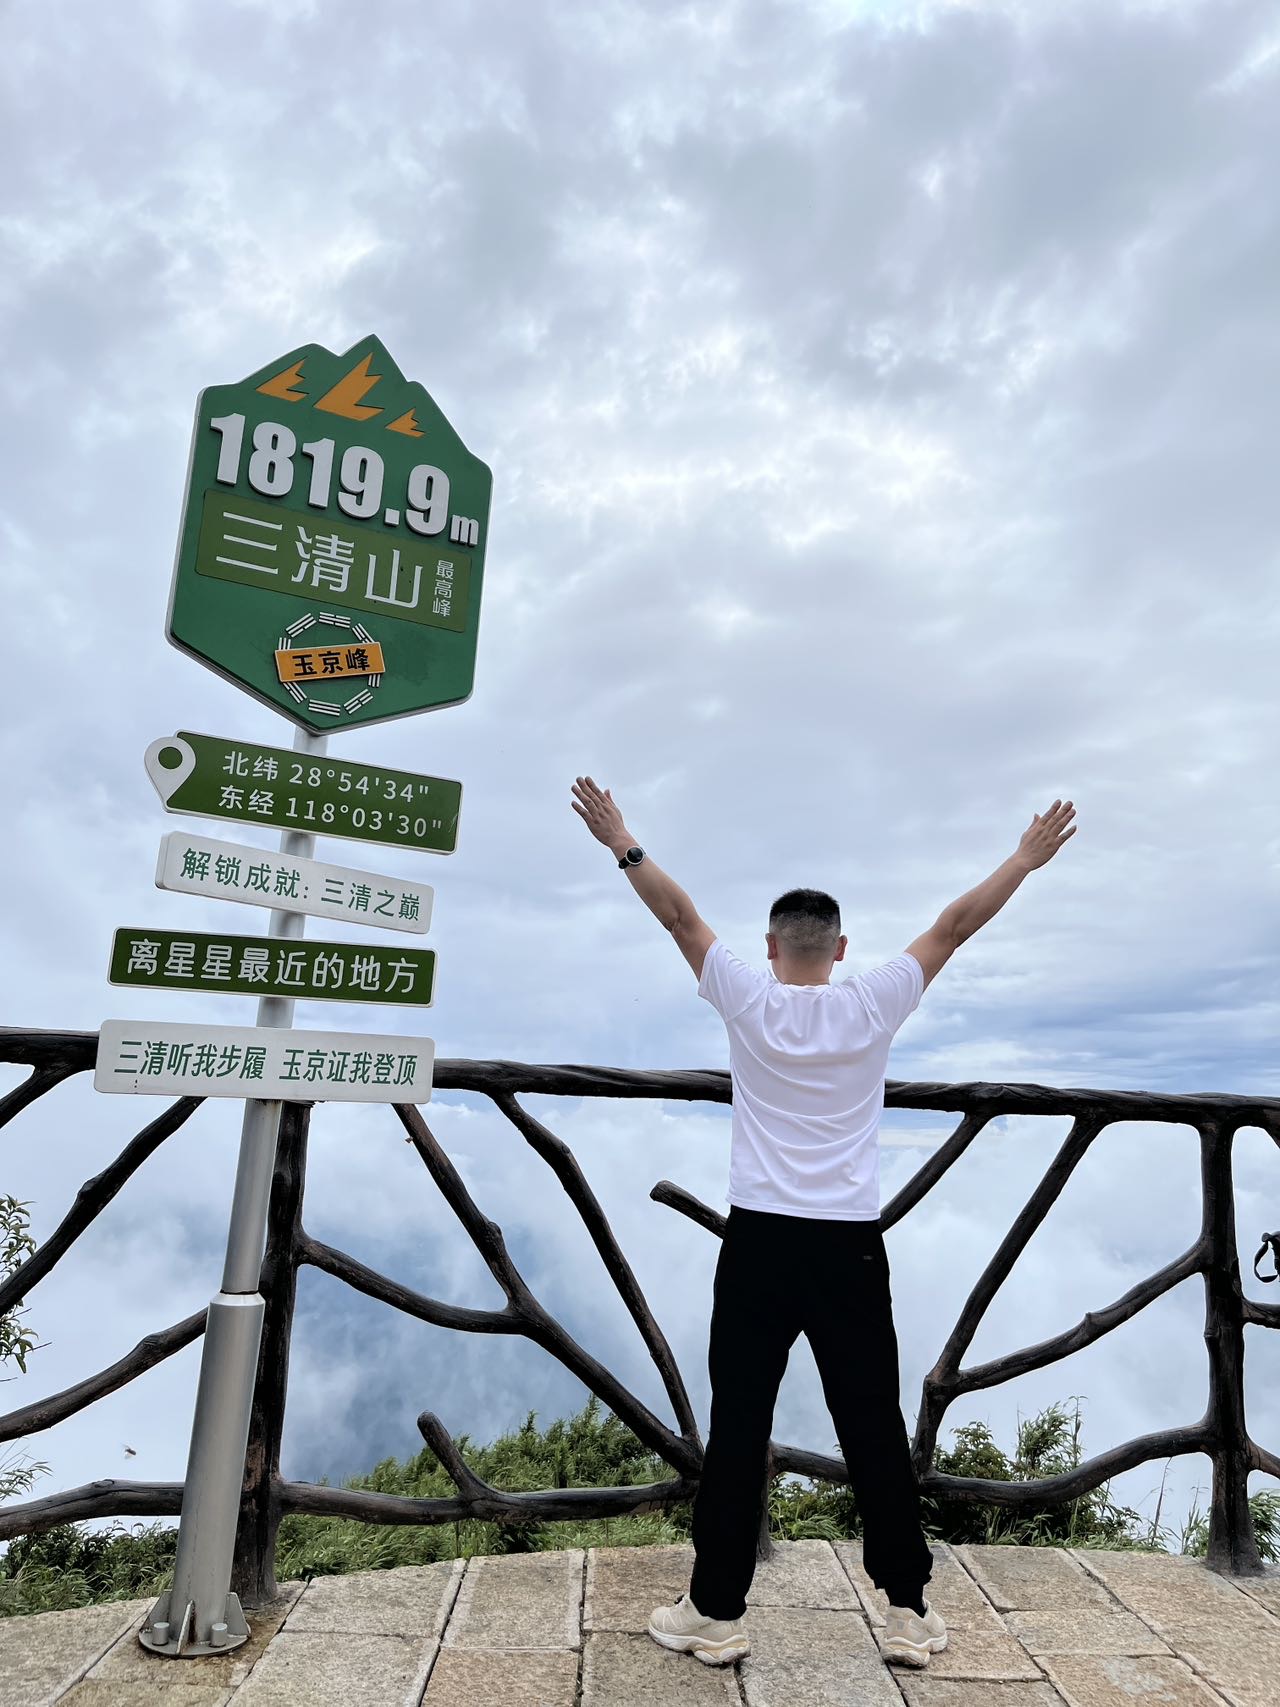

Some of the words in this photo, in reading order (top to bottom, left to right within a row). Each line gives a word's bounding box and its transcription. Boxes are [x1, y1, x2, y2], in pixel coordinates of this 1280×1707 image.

[210, 412, 480, 547] 1819.9m
[215, 511, 423, 609] 三清山
[432, 559, 454, 617] 最高峰
[292, 648, 370, 677] 玉京峰
[222, 750, 279, 781] 北纬
[218, 785, 275, 816] 东经
[127, 938, 419, 993] 离星星最近的地方
[114, 1040, 267, 1080] 三清听我步履
[278, 1047, 418, 1086] 玉京证我登顶
